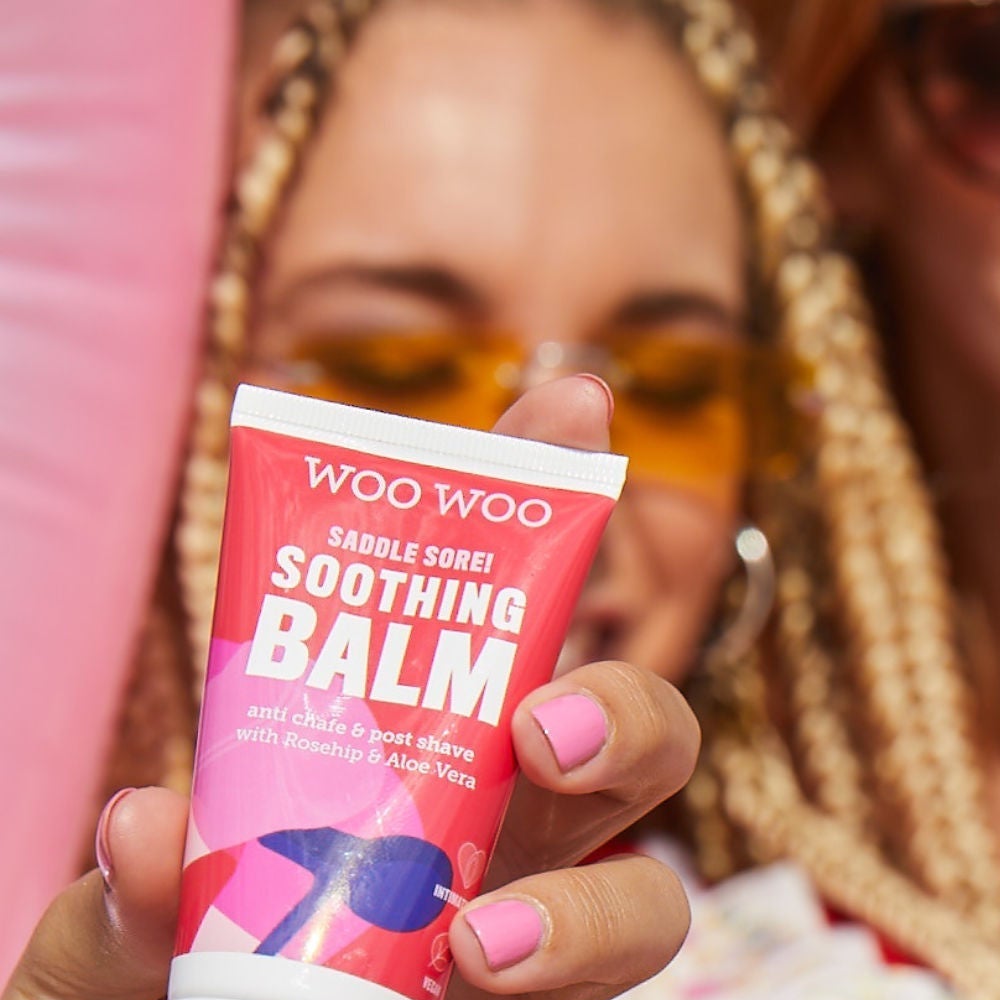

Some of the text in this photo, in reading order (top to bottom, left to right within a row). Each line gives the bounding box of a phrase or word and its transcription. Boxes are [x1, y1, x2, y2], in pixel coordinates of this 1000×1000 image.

[304, 455, 554, 528] WOO WOO
[327, 525, 495, 574] SADDLE SORE!
[271, 545, 527, 634] SOOTHING
[245, 594, 518, 727] BALM
[236, 726, 477, 790] with Rosehip & Aloe Vera
[247, 704, 475, 763] anti chafe & post shave
